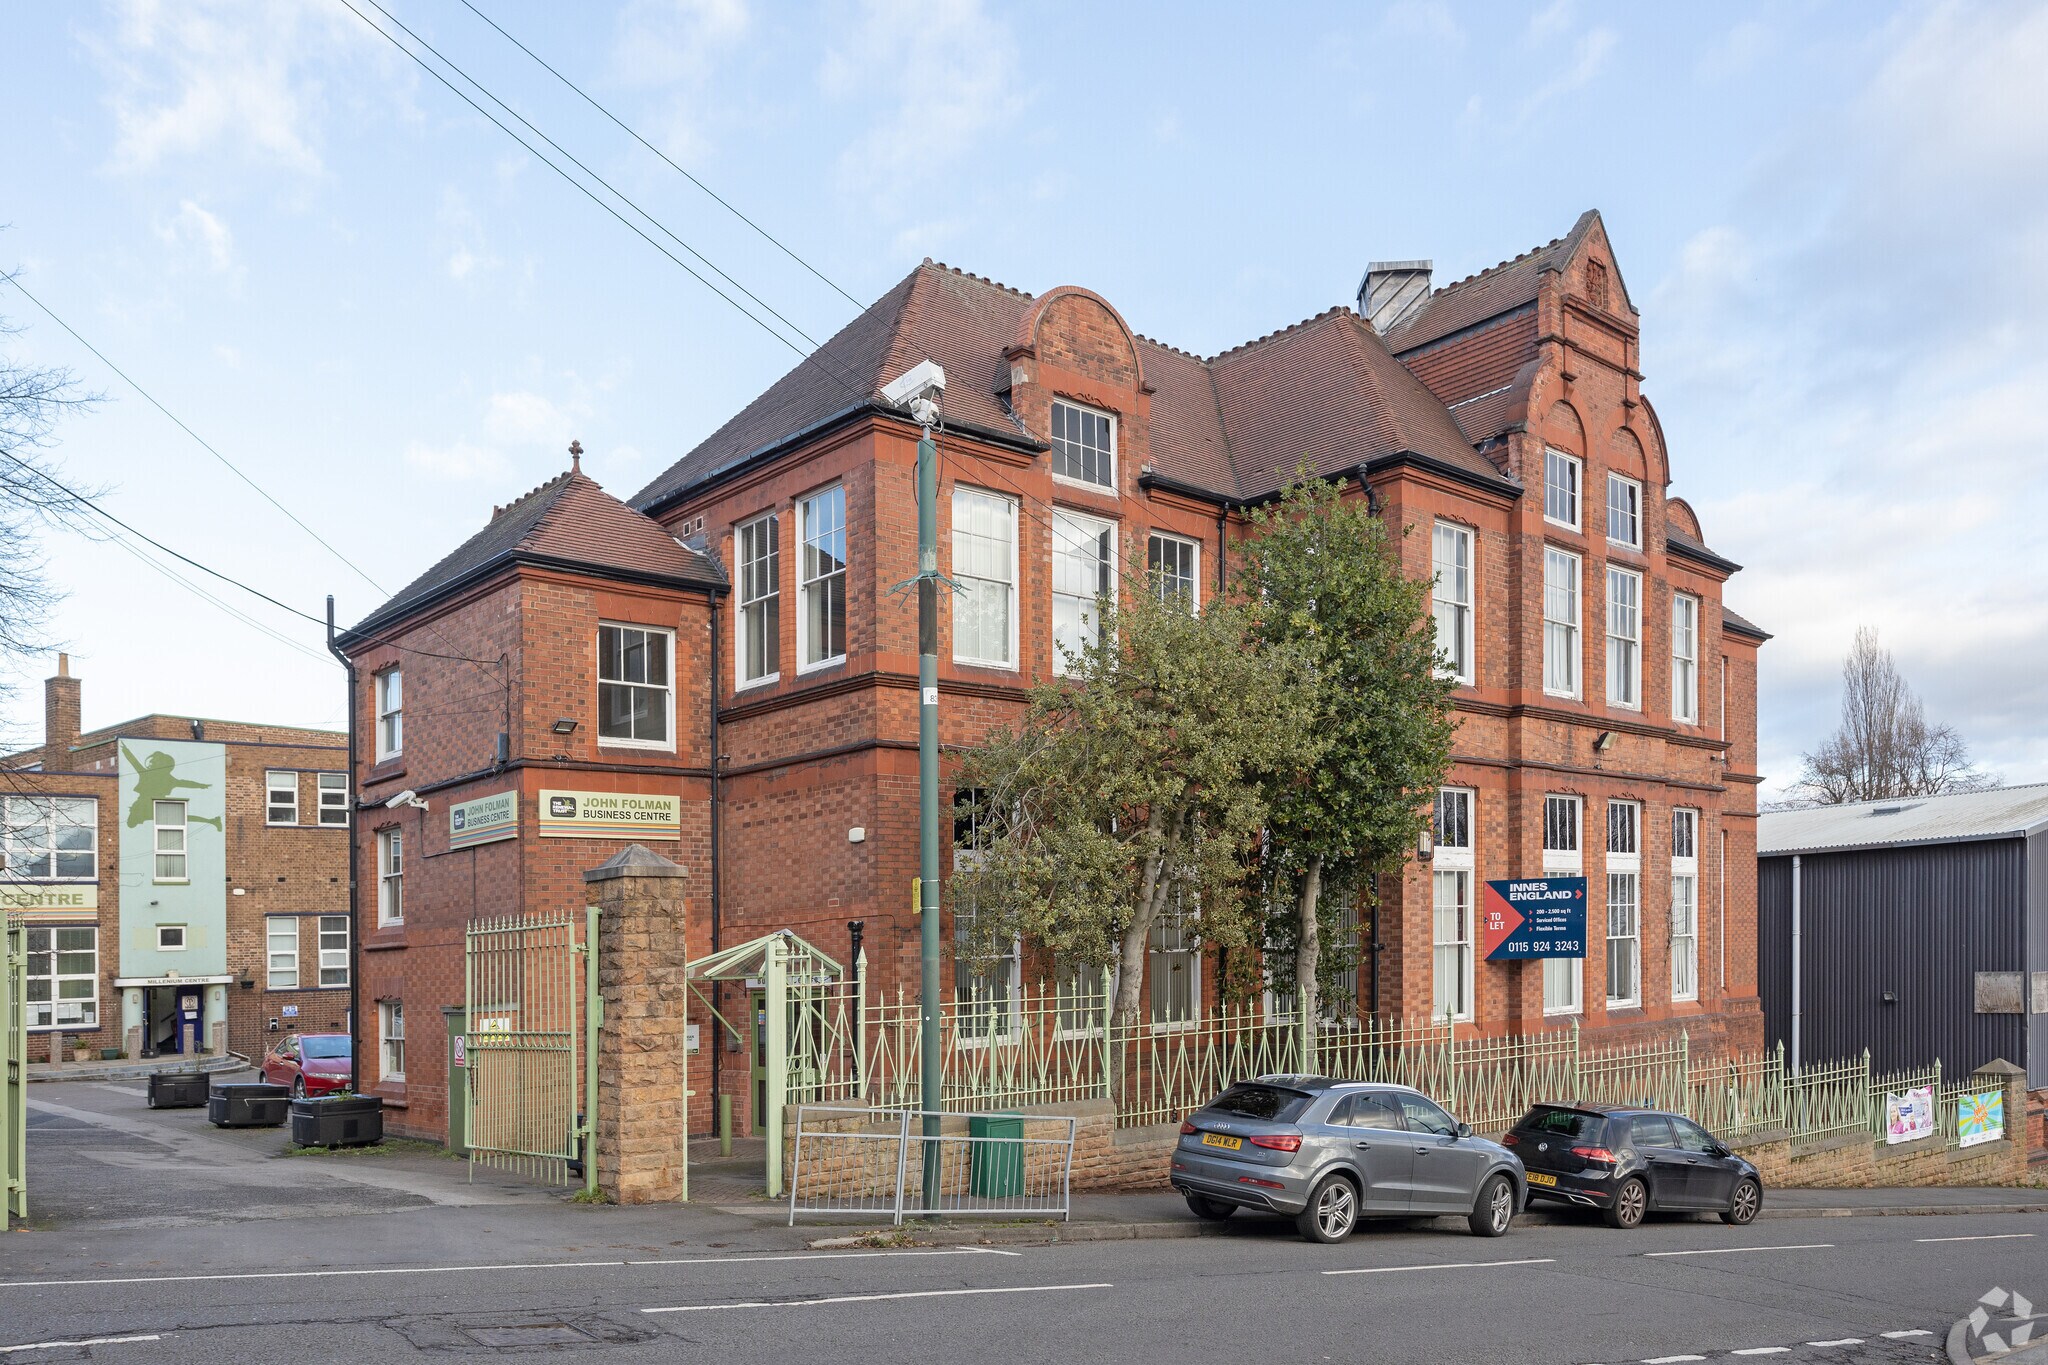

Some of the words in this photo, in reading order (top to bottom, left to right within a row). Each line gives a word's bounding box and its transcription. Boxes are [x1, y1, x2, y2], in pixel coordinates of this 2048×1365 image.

[467, 804, 484, 816] JOHN
[485, 798, 509, 813] FOLMAN
[583, 797, 618, 808] JOHN
[622, 799, 671, 810] FOLMAN
[467, 814, 490, 827] BUSINESS
[490, 810, 510, 822] CENTRE
[583, 809, 632, 820] BUSINESS
[634, 811, 671, 821] CENTRE
[1509, 882, 1548, 892] INNES
[2, 893, 84, 906] CENTRE
[1509, 890, 1572, 901] ENGLAND
[1490, 912, 1501, 921] TO
[1489, 921, 1505, 930] LET
[1508, 941, 1529, 952] 0115
[1533, 941, 1551, 952] 924
[1554, 940, 1579, 951] 3243
[1206, 1134, 1222, 1145] DG14
[1223, 1137, 1237, 1148] WLR
